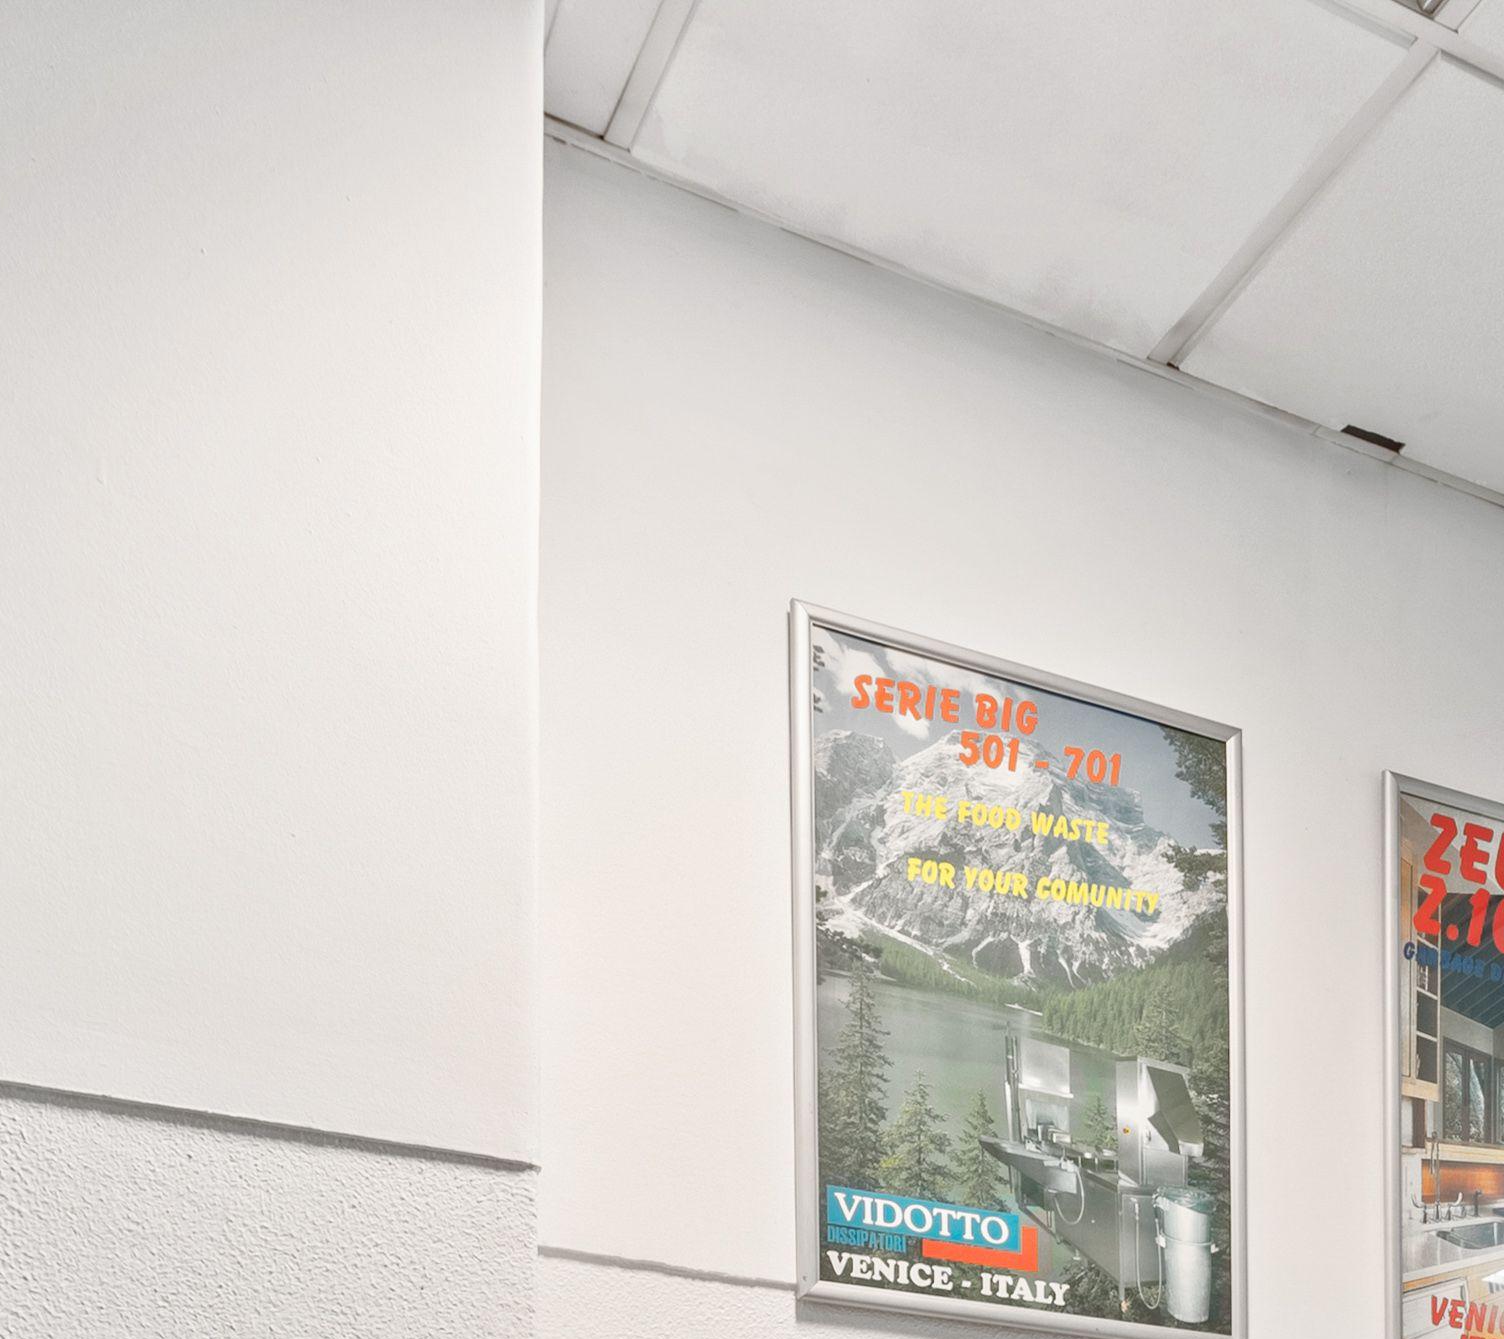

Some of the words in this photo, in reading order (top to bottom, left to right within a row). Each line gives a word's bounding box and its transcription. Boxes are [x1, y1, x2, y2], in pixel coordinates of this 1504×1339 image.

[851, 674, 960, 724] SERIE
[975, 692, 1039, 735] BIG
[958, 730, 1021, 772] 501
[1063, 745, 1122, 788] 701
[902, 791, 947, 820] THE
[958, 802, 1022, 832] FOOD
[1031, 811, 1110, 846] WASTE
[907, 857, 956, 890] FOR
[963, 865, 1029, 899] YOUR
[1036, 877, 1160, 916] COMUNITY
[827, 1224, 907, 1254] DISSIPATORI
[834, 1191, 1010, 1245] VIDOTTO
[826, 1250, 954, 1291] VENICE
[981, 1272, 1071, 1306] ITALY
